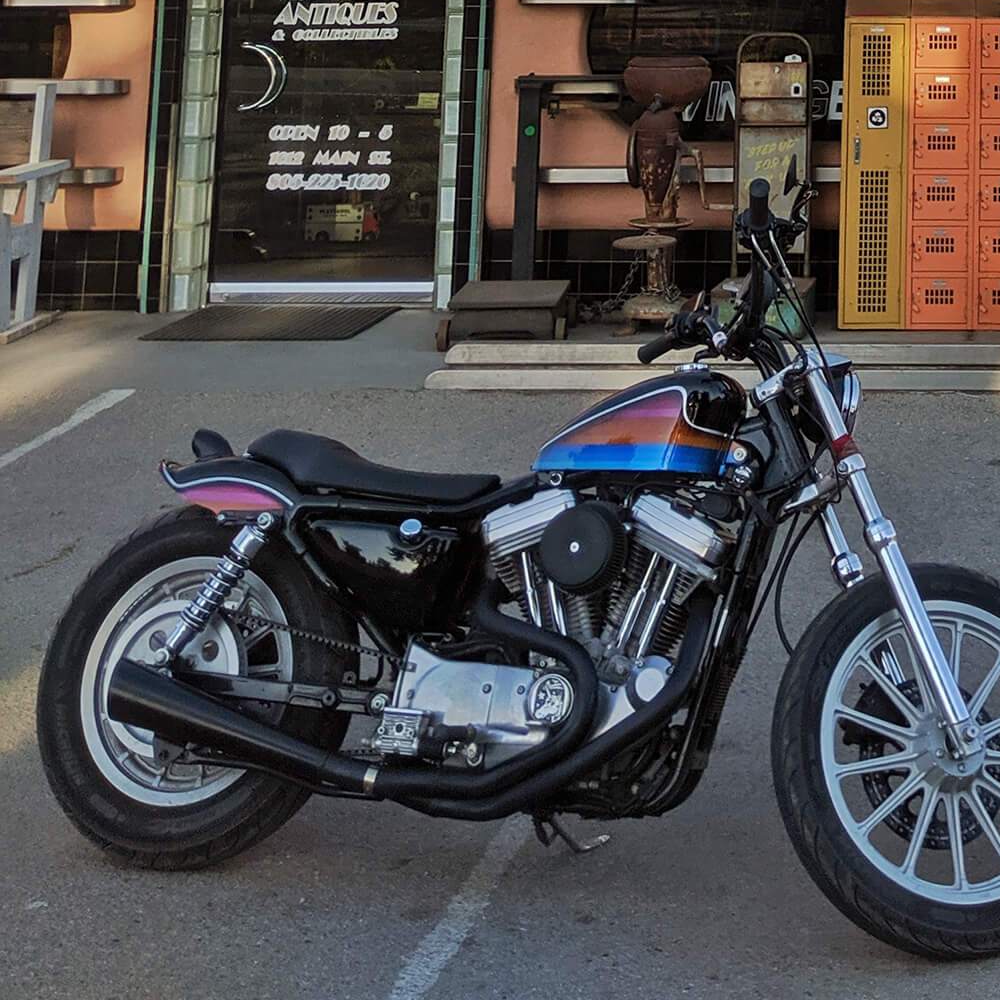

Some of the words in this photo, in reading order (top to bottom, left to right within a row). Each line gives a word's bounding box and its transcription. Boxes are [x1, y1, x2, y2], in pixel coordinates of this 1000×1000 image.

[274, 1, 399, 25] ANTIQUES
[272, 30, 285, 40] &
[293, 29, 399, 40] COLLECTIBLES
[269, 125, 319, 141] OPEN
[328, 125, 350, 140] 10
[312, 150, 360, 165] MAIN
